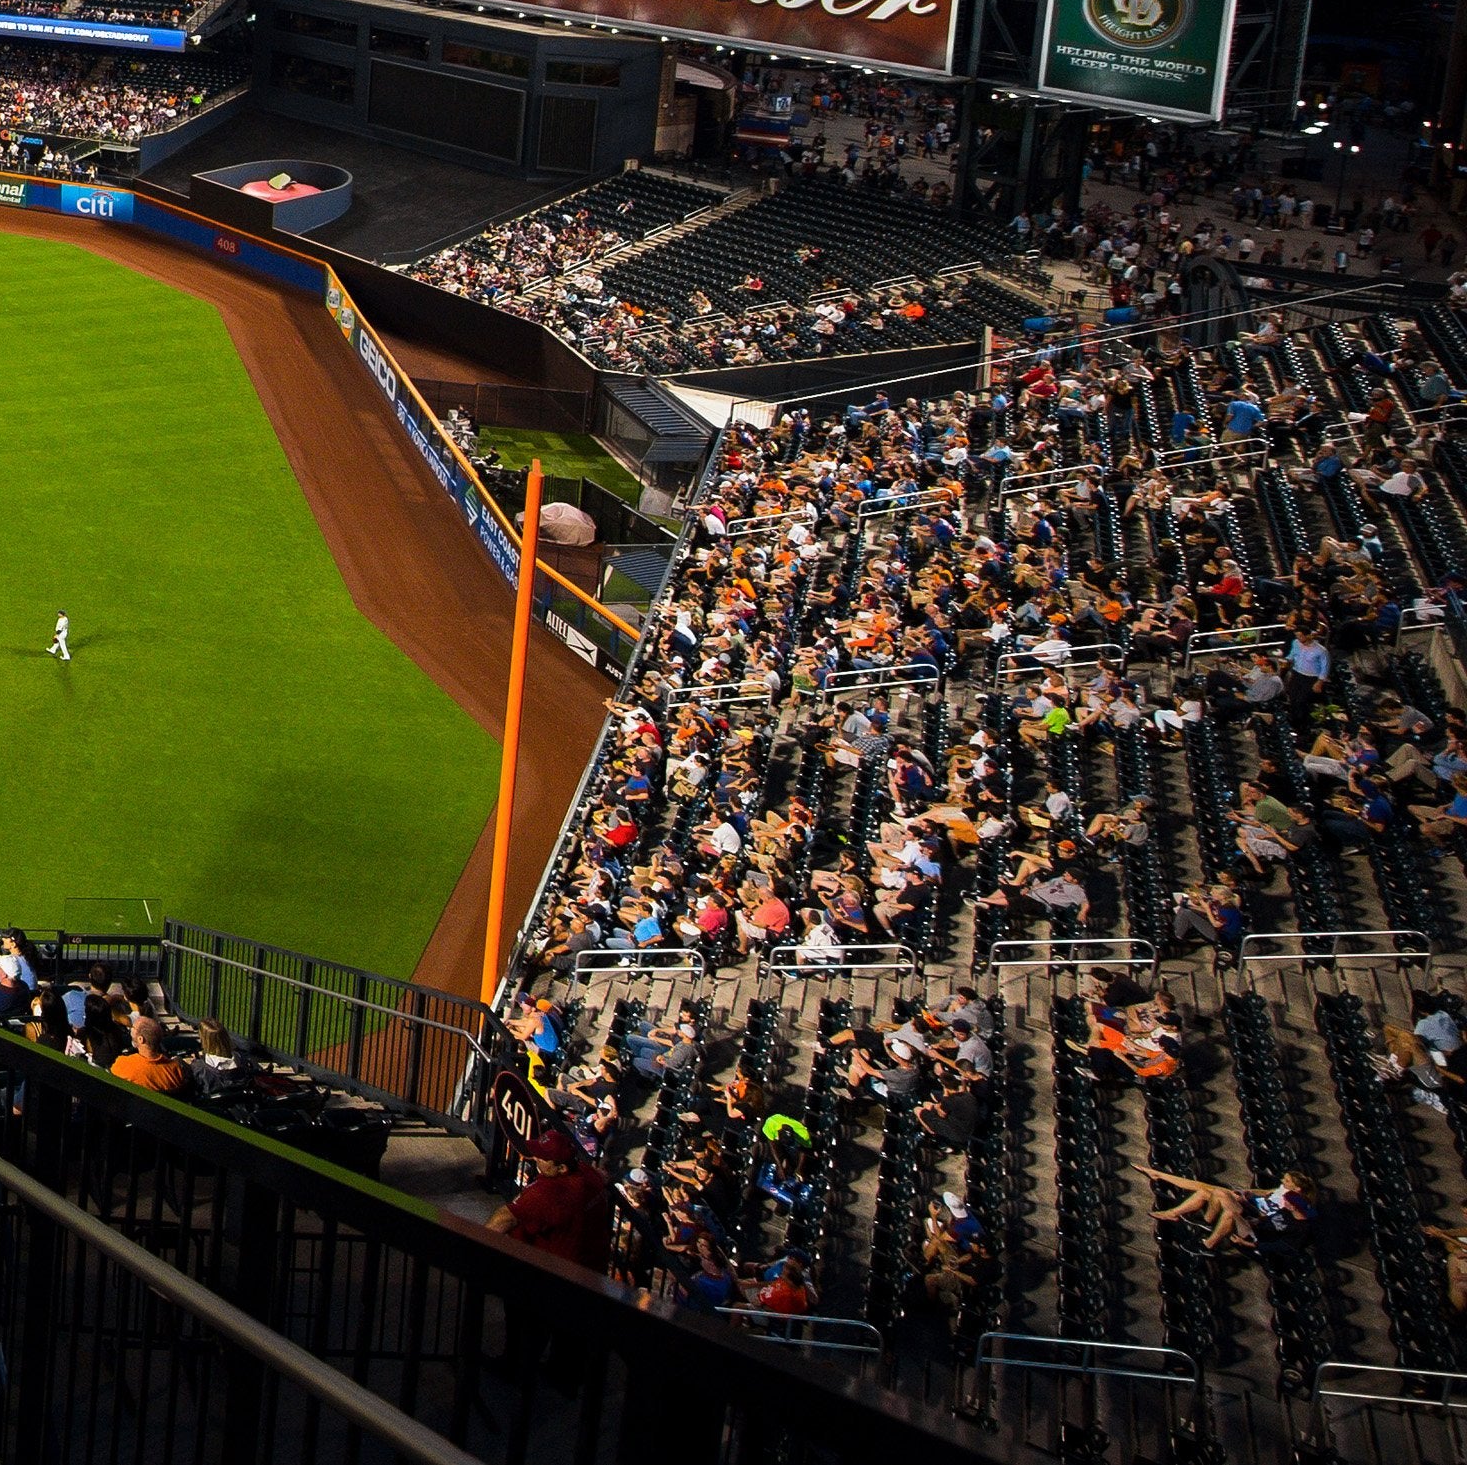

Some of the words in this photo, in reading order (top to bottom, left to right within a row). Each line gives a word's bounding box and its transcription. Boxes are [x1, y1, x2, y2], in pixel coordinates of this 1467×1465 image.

[1098, 14, 1142, 40] FREIGHT
[1143, 21, 1168, 38] LINE
[1056, 45, 1117, 60] HELPING
[1121, 54, 1150, 66] THE
[1153, 59, 1206, 75] WORLD
[1070, 57, 1109, 70] KEEP
[76, 196, 114, 217] citi
[216, 236, 236, 254] 408
[359, 328, 397, 402] GEICO
[479, 525, 501, 566] POWER
[481, 504, 498, 538] EAST
[498, 529, 520, 569] COAST
[501, 1089, 532, 1141] 401
